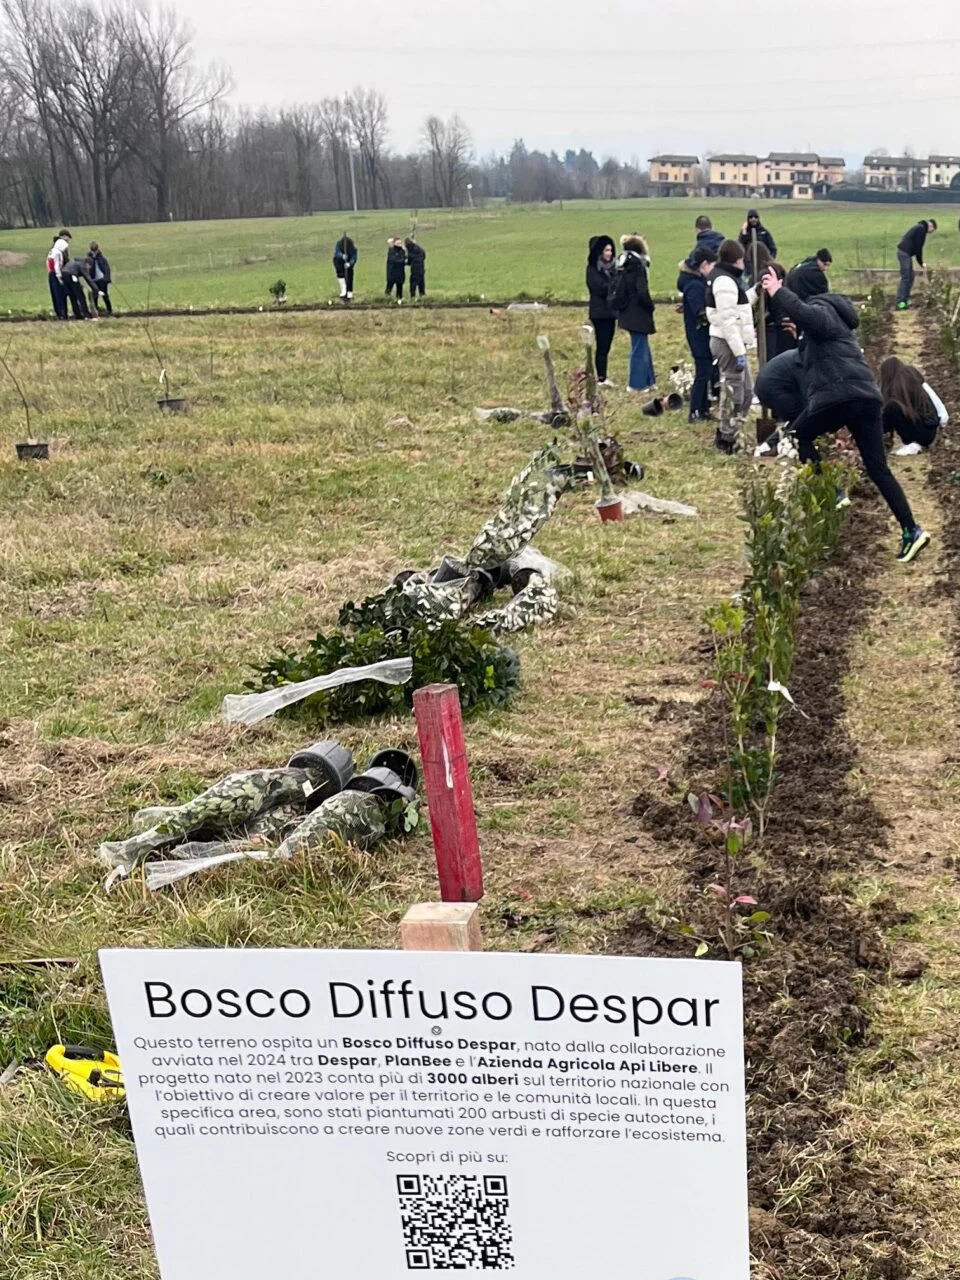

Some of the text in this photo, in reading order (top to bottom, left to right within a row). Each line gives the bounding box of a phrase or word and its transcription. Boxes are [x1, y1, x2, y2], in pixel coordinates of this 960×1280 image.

[144, 979, 719, 1037] Bosco Diffuso Despar
[134, 1036, 725, 1057] Questo terreno ospita un Bosco Diffuso Despar, nato dalla collaborazione
[152, 1055, 213, 1066] avviata
[219, 1054, 242, 1065] nel
[247, 1054, 286, 1065] 2024
[290, 1055, 313, 1065] tra
[318, 1055, 380, 1069] Despar,
[385, 1055, 451, 1066] PlanBee
[456, 1058, 464, 1068] e
[547, 1058, 615, 1073] Agricola
[620, 1060, 645, 1075] Api
[650, 1060, 701, 1073] Libere.
[706, 1063, 712, 1074] Il
[139, 1072, 729, 1092] progetto nato nel 2023 conta più di 3000 alberi sul territorio nazionale con
[239, 1089, 253, 1100] di
[258, 1092, 310, 1101] creare
[315, 1089, 364, 1100] valore
[370, 1092, 395, 1104] per
[400, 1090, 407, 1100] il
[412, 1090, 479, 1101] territorio
[484, 1093, 493, 1103] e
[498, 1091, 511, 1103] le
[516, 1093, 591, 1104] comunità
[596, 1093, 640, 1105] locali.
[645, 1096, 658, 1106] In
[663, 1098, 716, 1110] questa
[161, 1107, 715, 1126] specifica area, sono stati piantumati 200 arbusti di specie autoctone, i
[155, 1124, 195, 1139] quali
[200, 1123, 319, 1135] contribuiscono
[323, 1126, 333, 1135] a
[339, 1126, 389, 1135] creare
[395, 1126, 443, 1135] nuove
[448, 1127, 484, 1136] zone
[489, 1125, 527, 1136] verdi
[532, 1128, 540, 1137] e
[546, 1126, 620, 1138] rafforzare
[387, 1151, 508, 1165] Scopri di più su:
